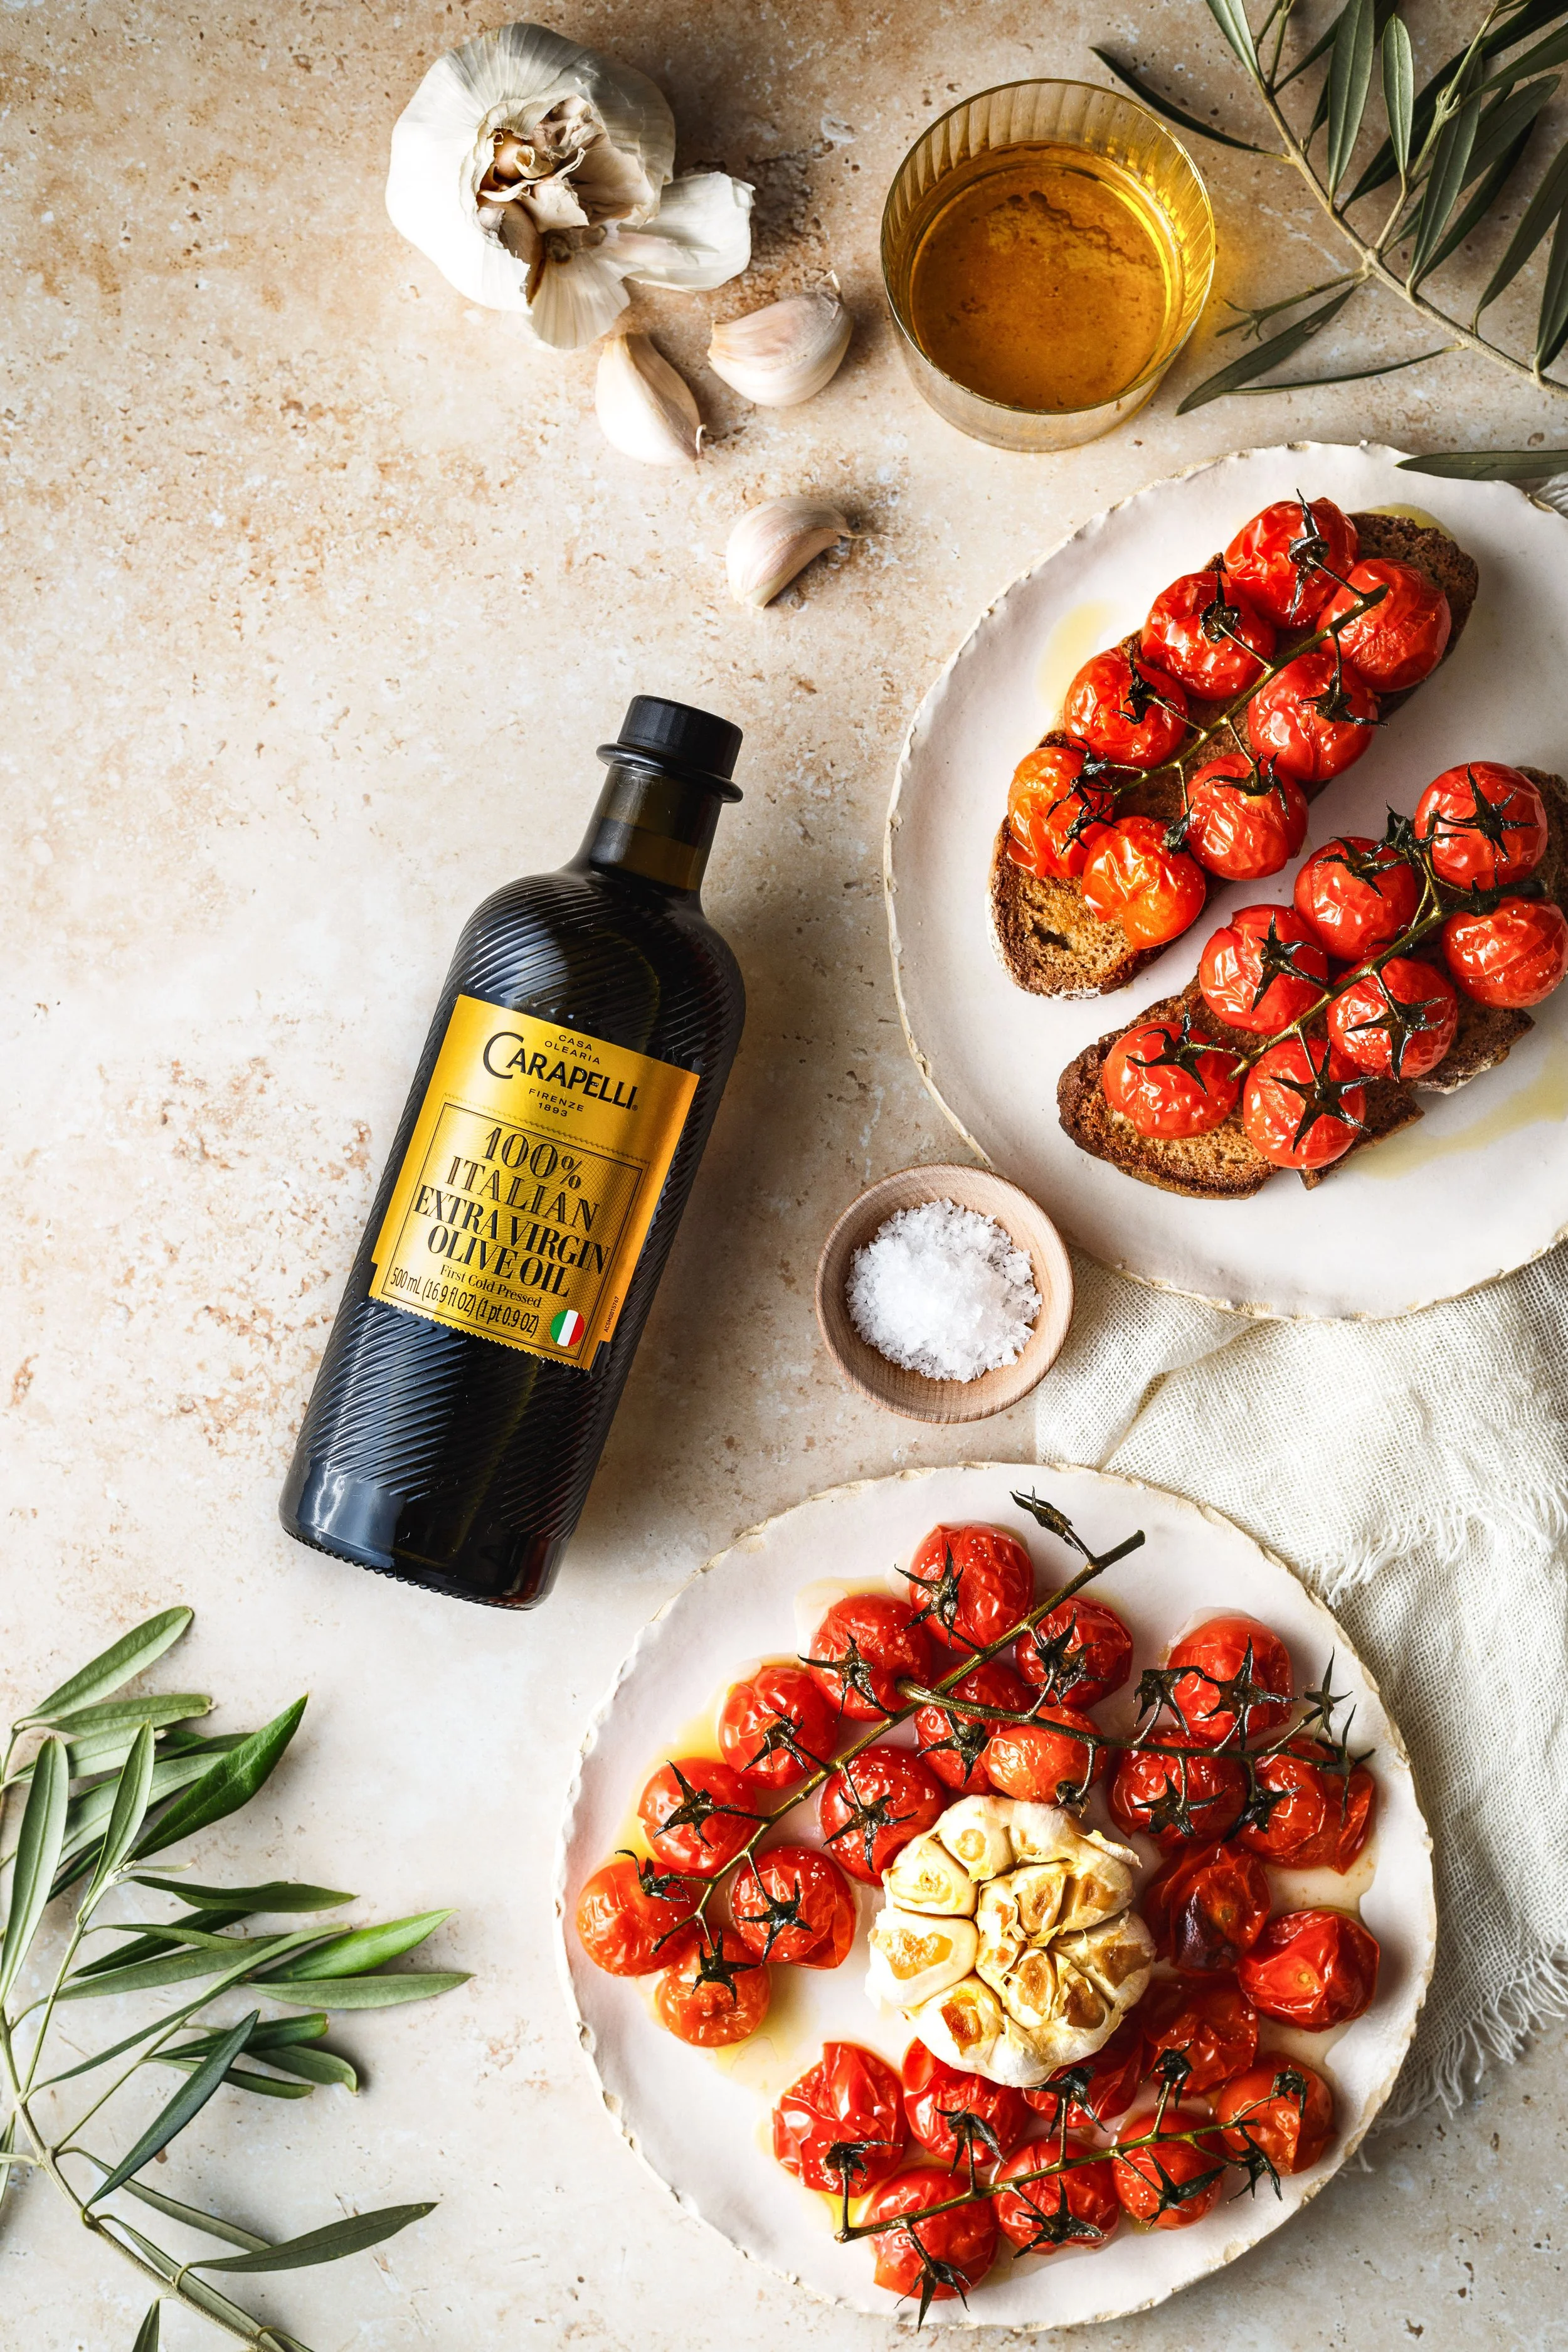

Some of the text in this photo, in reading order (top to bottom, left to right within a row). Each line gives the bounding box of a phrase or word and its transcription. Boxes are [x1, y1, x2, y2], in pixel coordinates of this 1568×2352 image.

[483, 1032, 637, 1110] CARAPELLI
[544, 1041, 600, 1064] OLEARIA
[559, 1034, 592, 1051] CASA
[529, 1088, 584, 1112] FIRENZE
[539, 1102, 568, 1117] 1893
[482, 1126, 581, 1189] 100%
[445, 1156, 600, 1232] ITALIAN
[413, 1184, 610, 1274] EXTRA VIRGIN
[428, 1226, 570, 1298] OLIVE OIL
[440, 1264, 542, 1308] First Cold Pressed
[390, 1267, 539, 1338] 500 mL (16.9 fl OZ) (1 pt 0.9 OZ)
